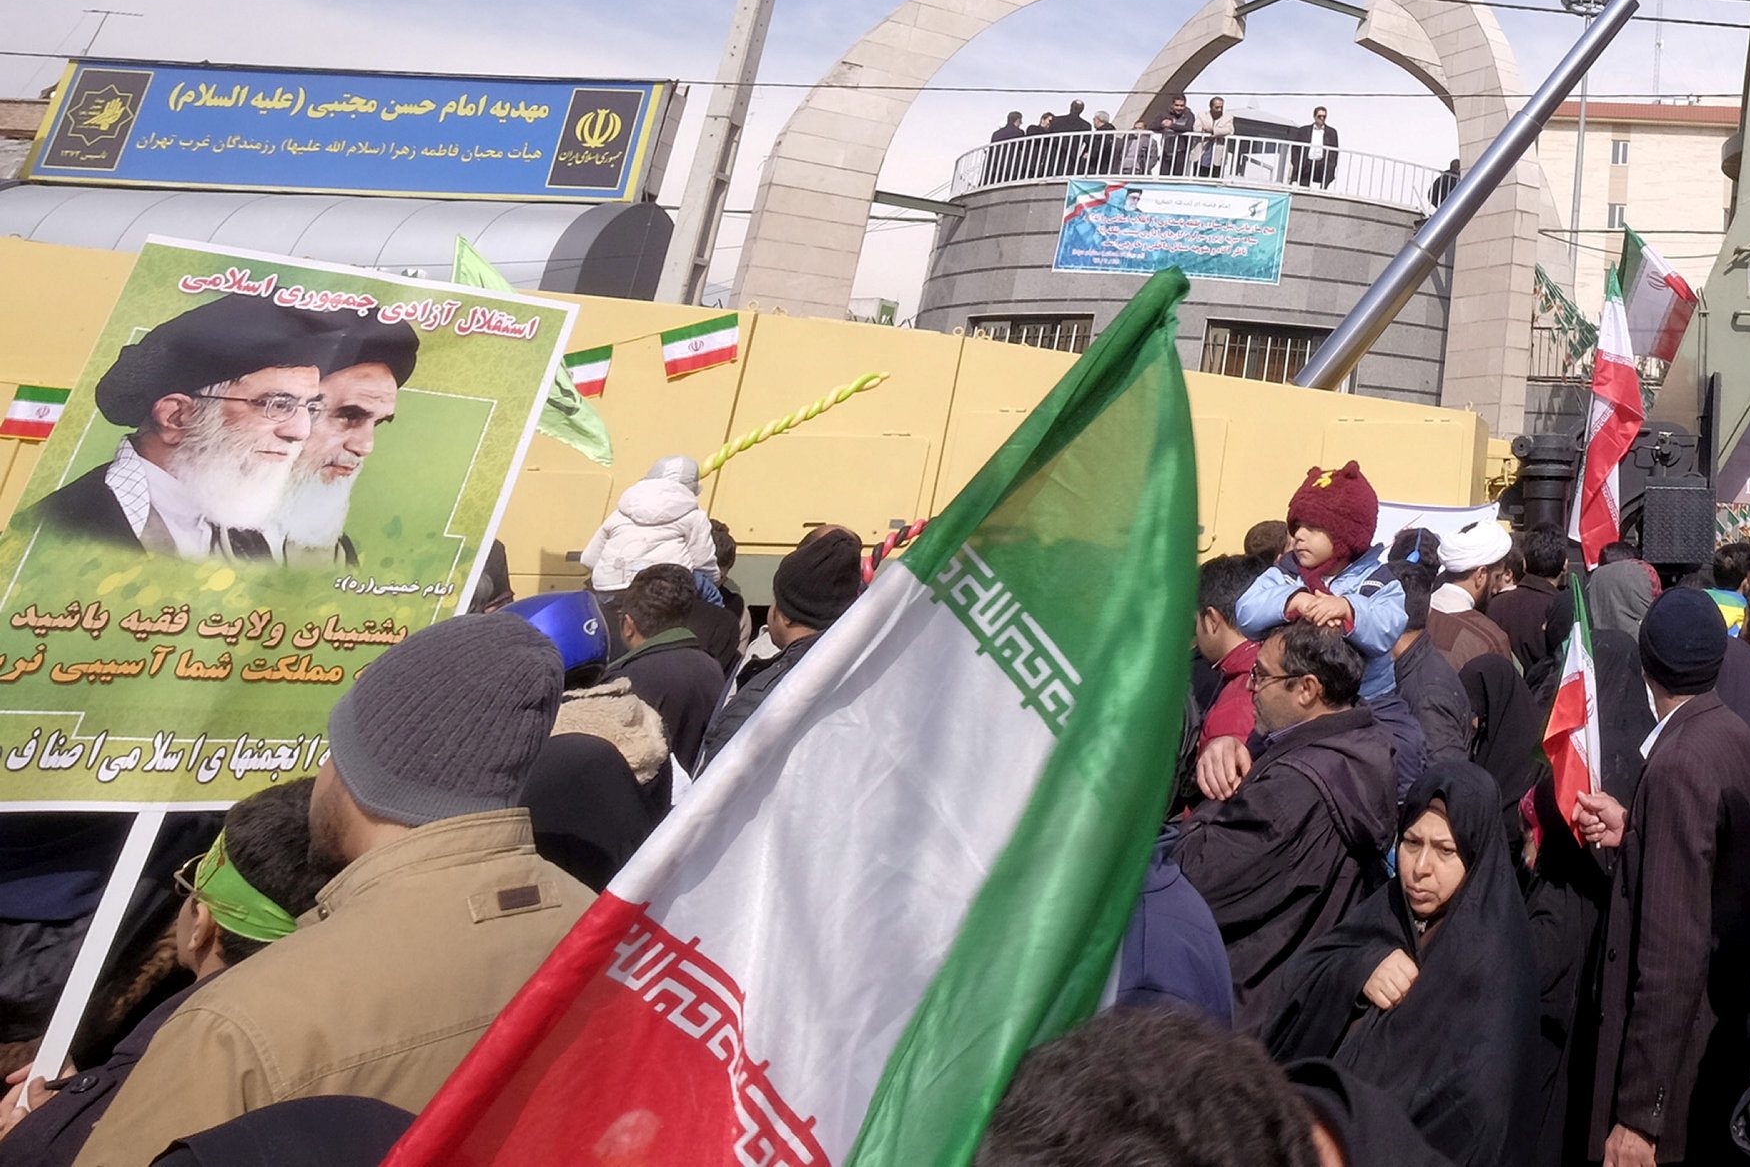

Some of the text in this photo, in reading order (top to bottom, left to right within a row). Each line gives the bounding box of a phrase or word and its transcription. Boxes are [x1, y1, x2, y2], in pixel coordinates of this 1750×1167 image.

[168, 82, 550, 123] مهدیه امام حسن مجتبی (علیه السلام)
[136, 132, 177, 150] تهران
[178, 133, 211, 151] غرب
[212, 136, 276, 154] رزمندگان
[281, 138, 321, 155] علیها)
[325, 139, 346, 153] الله
[347, 140, 386, 156] (سلام
[389, 141, 417, 160] زهرا
[420, 142, 460, 158] فاطمه
[460, 145, 504, 163] محبان
[178, 266, 541, 341] استقلال آزادی جمهوری اسلامی
[422, 581, 455, 598] امام
[10, 600, 111, 639] باشید
[119, 603, 191, 641] فقیه
[197, 609, 285, 648] ولایت
[50, 644, 174, 685] آسیبی
[173, 649, 235, 680] شما
[240, 654, 345, 685] مملکت
[5, 726, 109, 772] اصناف
[96, 729, 208, 784] اسلامی
